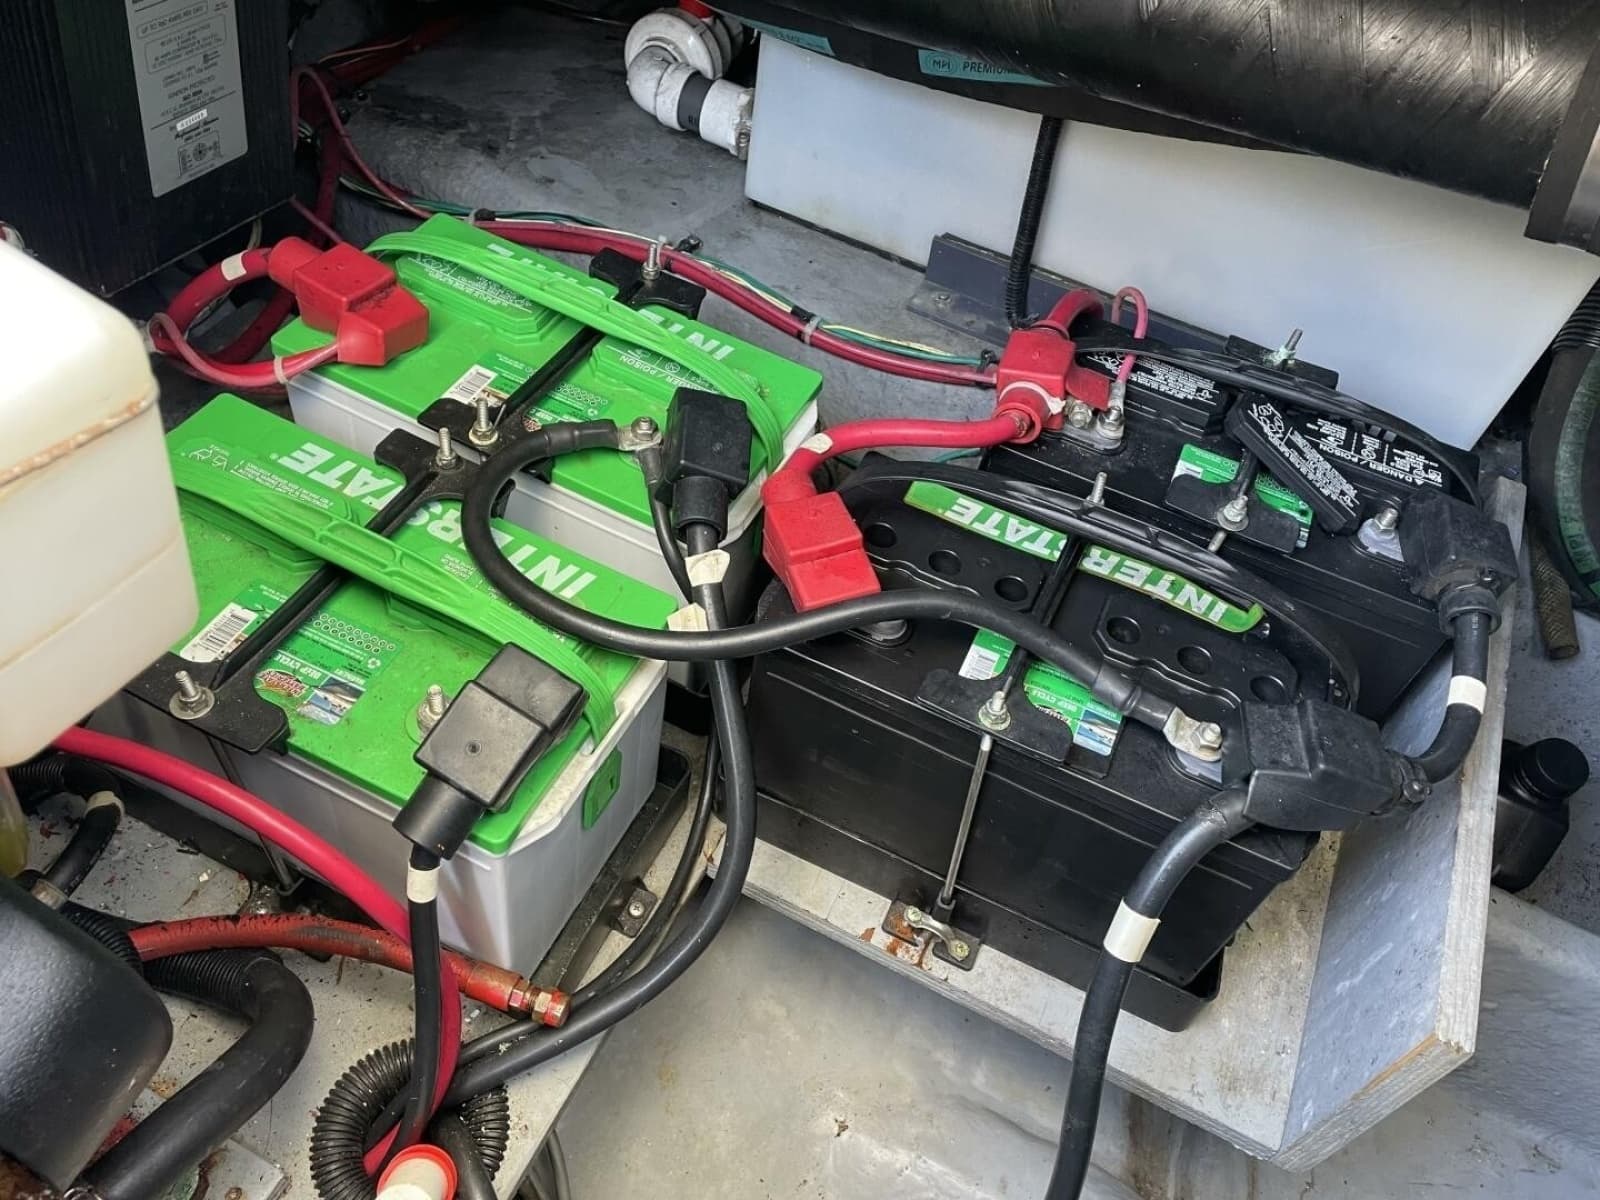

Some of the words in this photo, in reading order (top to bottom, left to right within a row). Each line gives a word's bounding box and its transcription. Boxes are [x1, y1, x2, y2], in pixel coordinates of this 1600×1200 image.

[619, 354, 658, 376] POISON
[1319, 442, 1359, 463] POISON
[1368, 460, 1413, 483] DANGER
